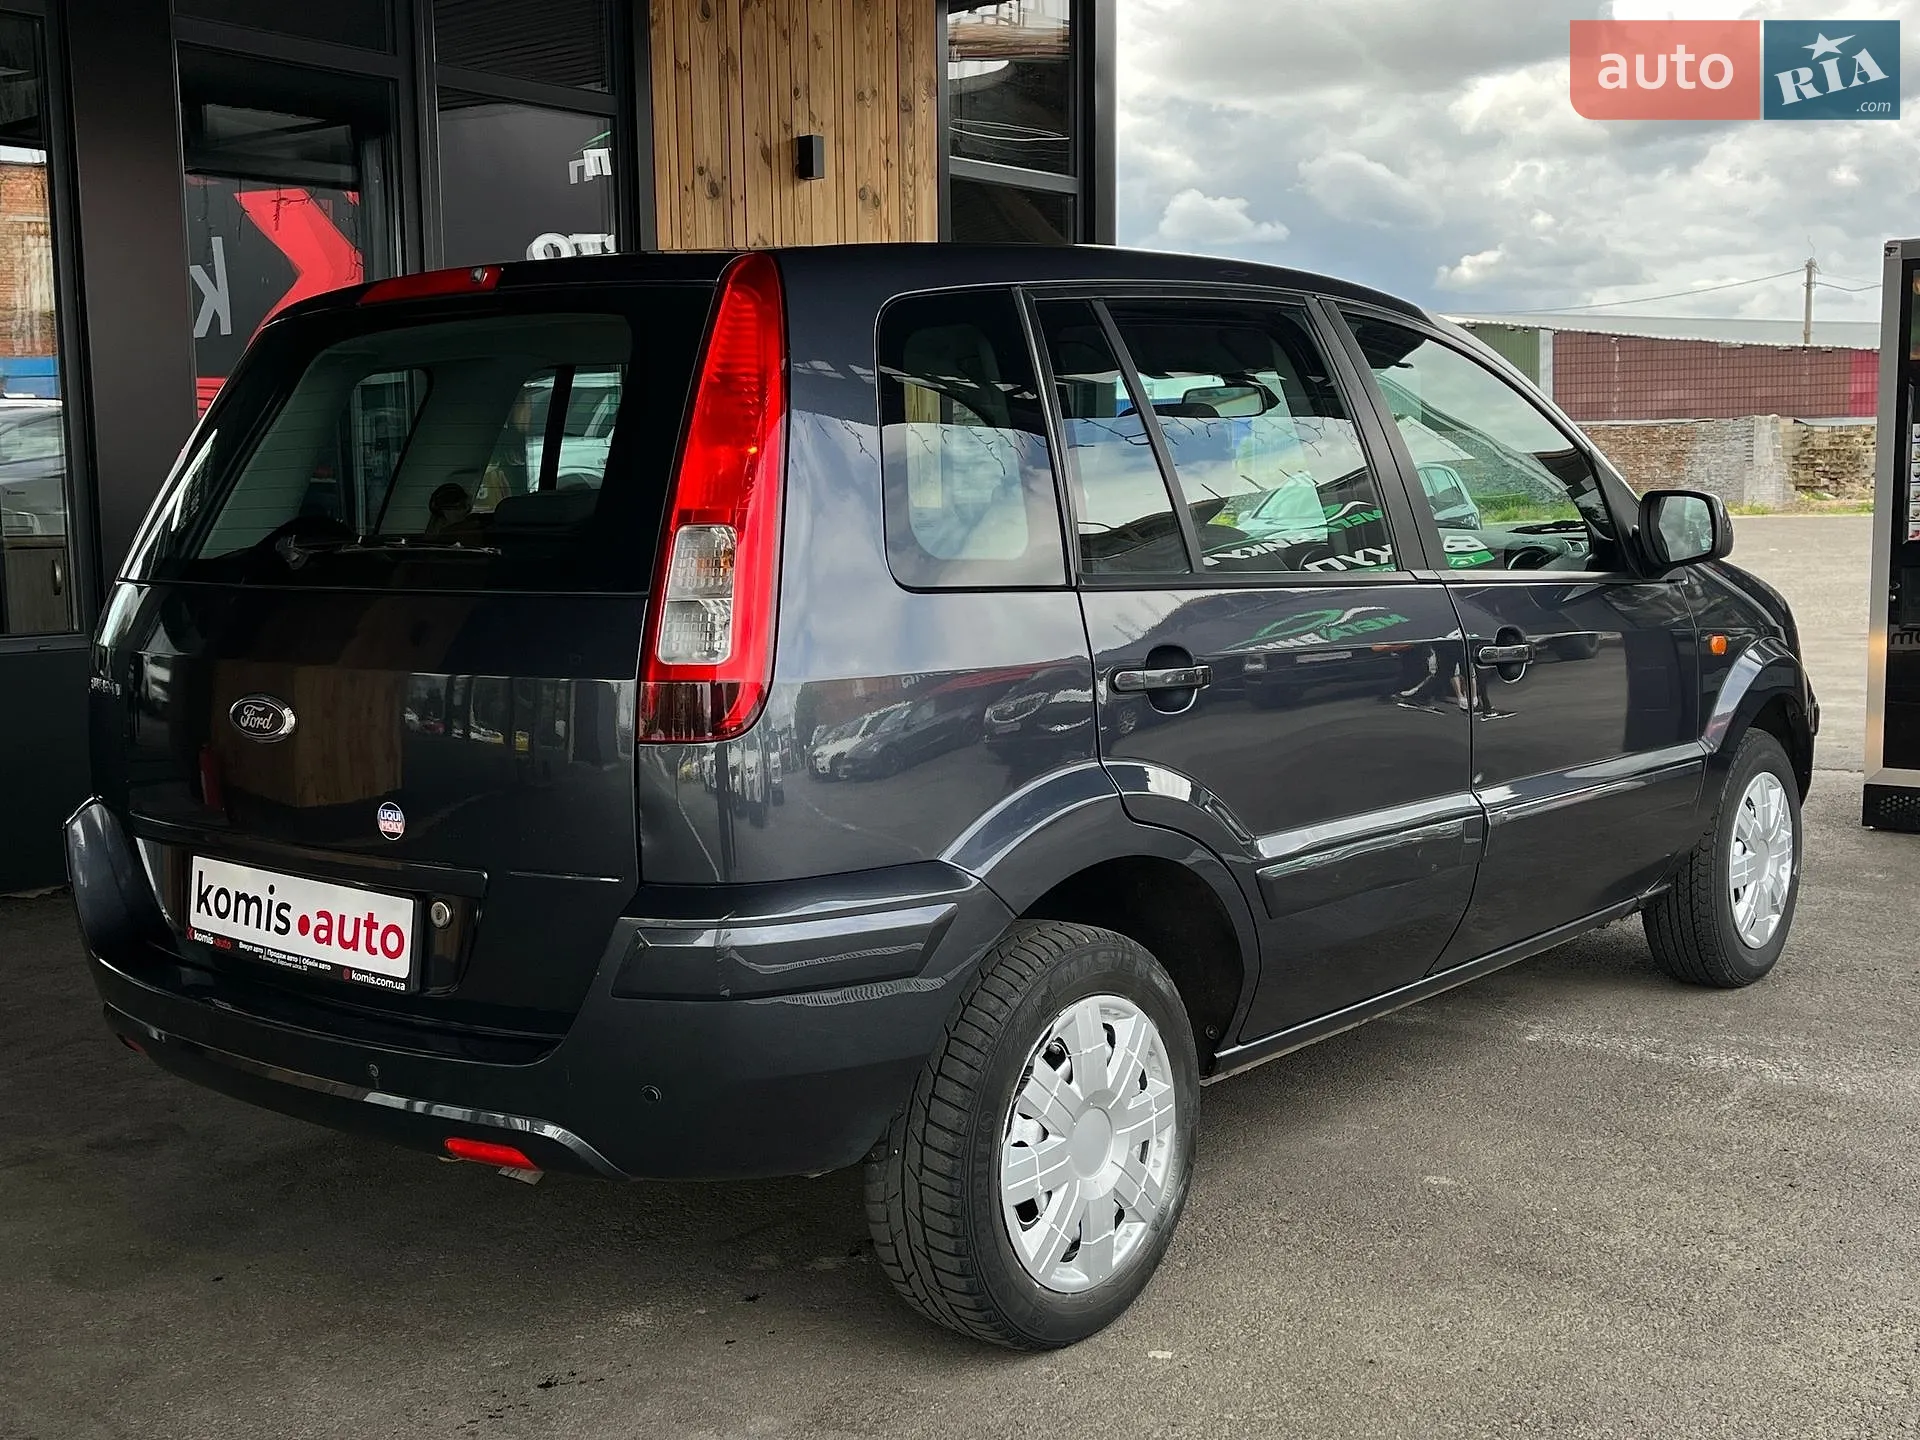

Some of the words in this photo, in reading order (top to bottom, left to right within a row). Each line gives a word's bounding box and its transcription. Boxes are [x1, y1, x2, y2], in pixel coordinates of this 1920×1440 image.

[240, 704, 274, 730] Ford
[380, 811, 401, 822] LIQUI
[380, 822, 402, 833] MOLY
[352, 970, 405, 991] komis.com.ua
